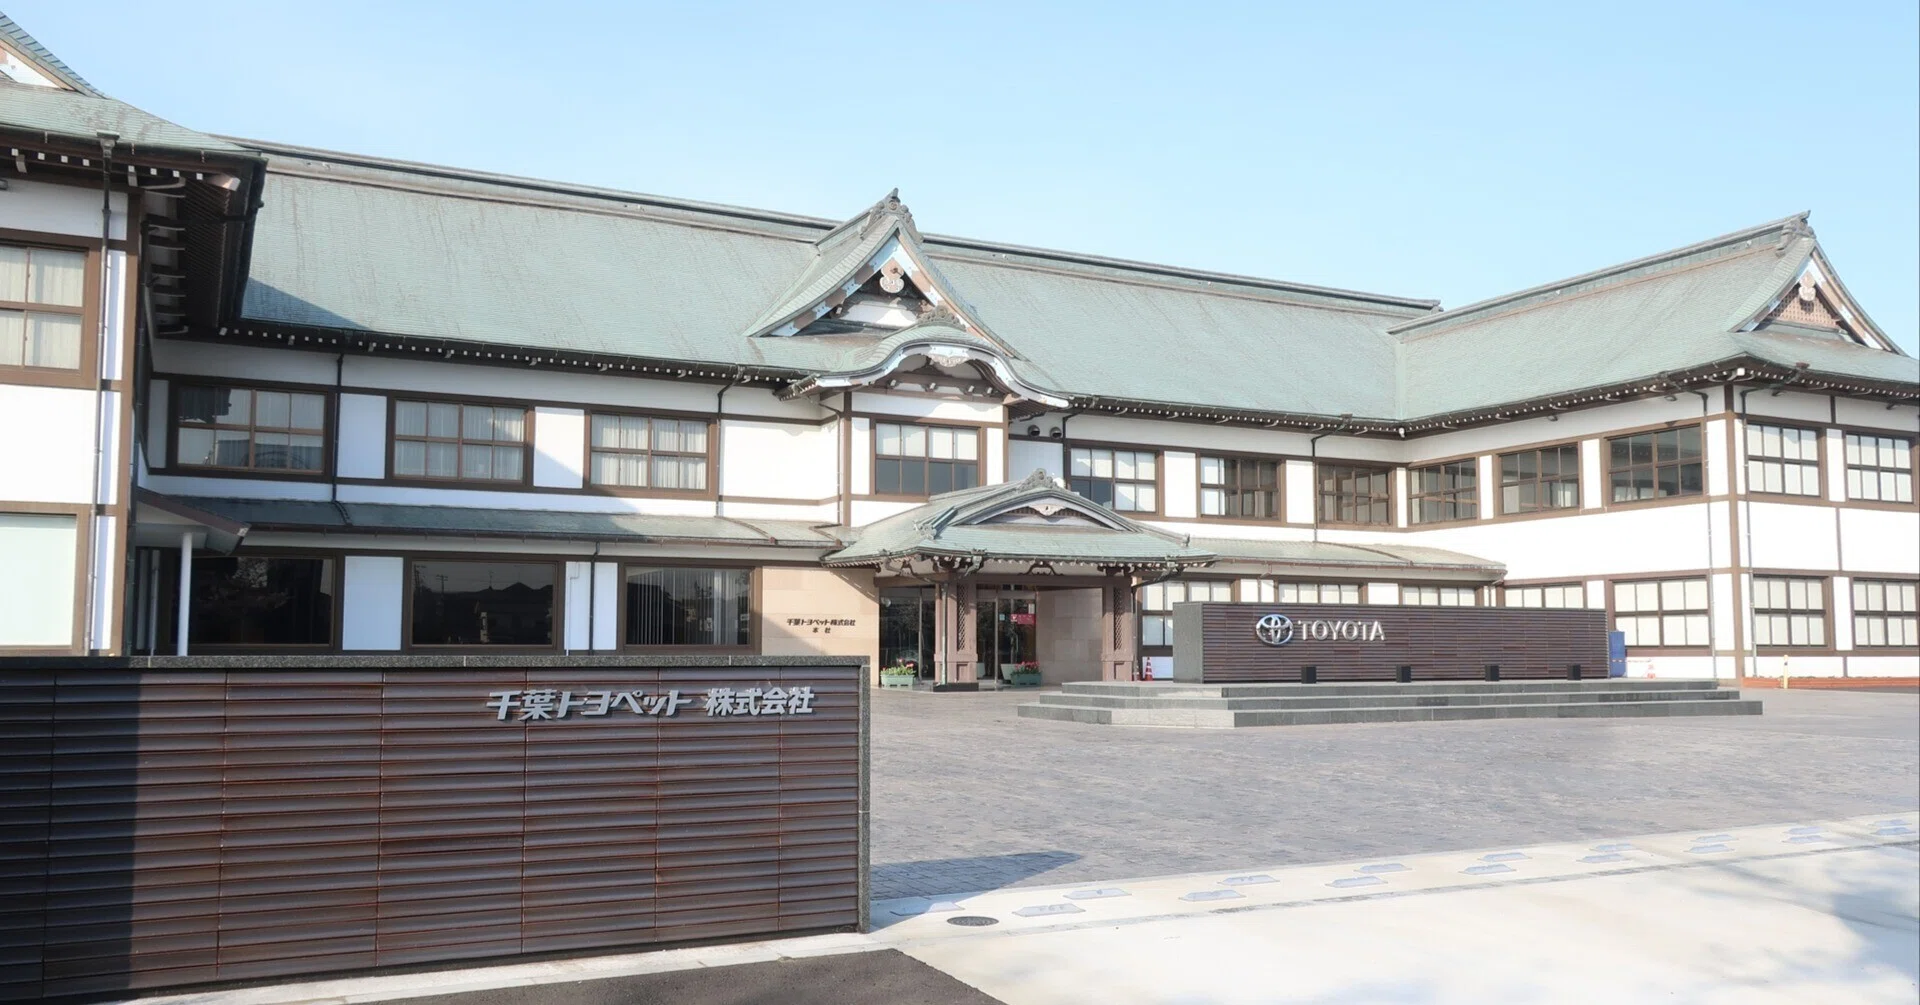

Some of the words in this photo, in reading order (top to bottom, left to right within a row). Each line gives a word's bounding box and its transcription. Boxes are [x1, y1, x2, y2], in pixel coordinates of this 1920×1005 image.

[786, 618, 856, 626] 千葉トヨペット株式会社
[1297, 620, 1386, 641] TOYOTA
[486, 689, 693, 721] 千葉トヨペット
[705, 686, 815, 716] 株式会社
